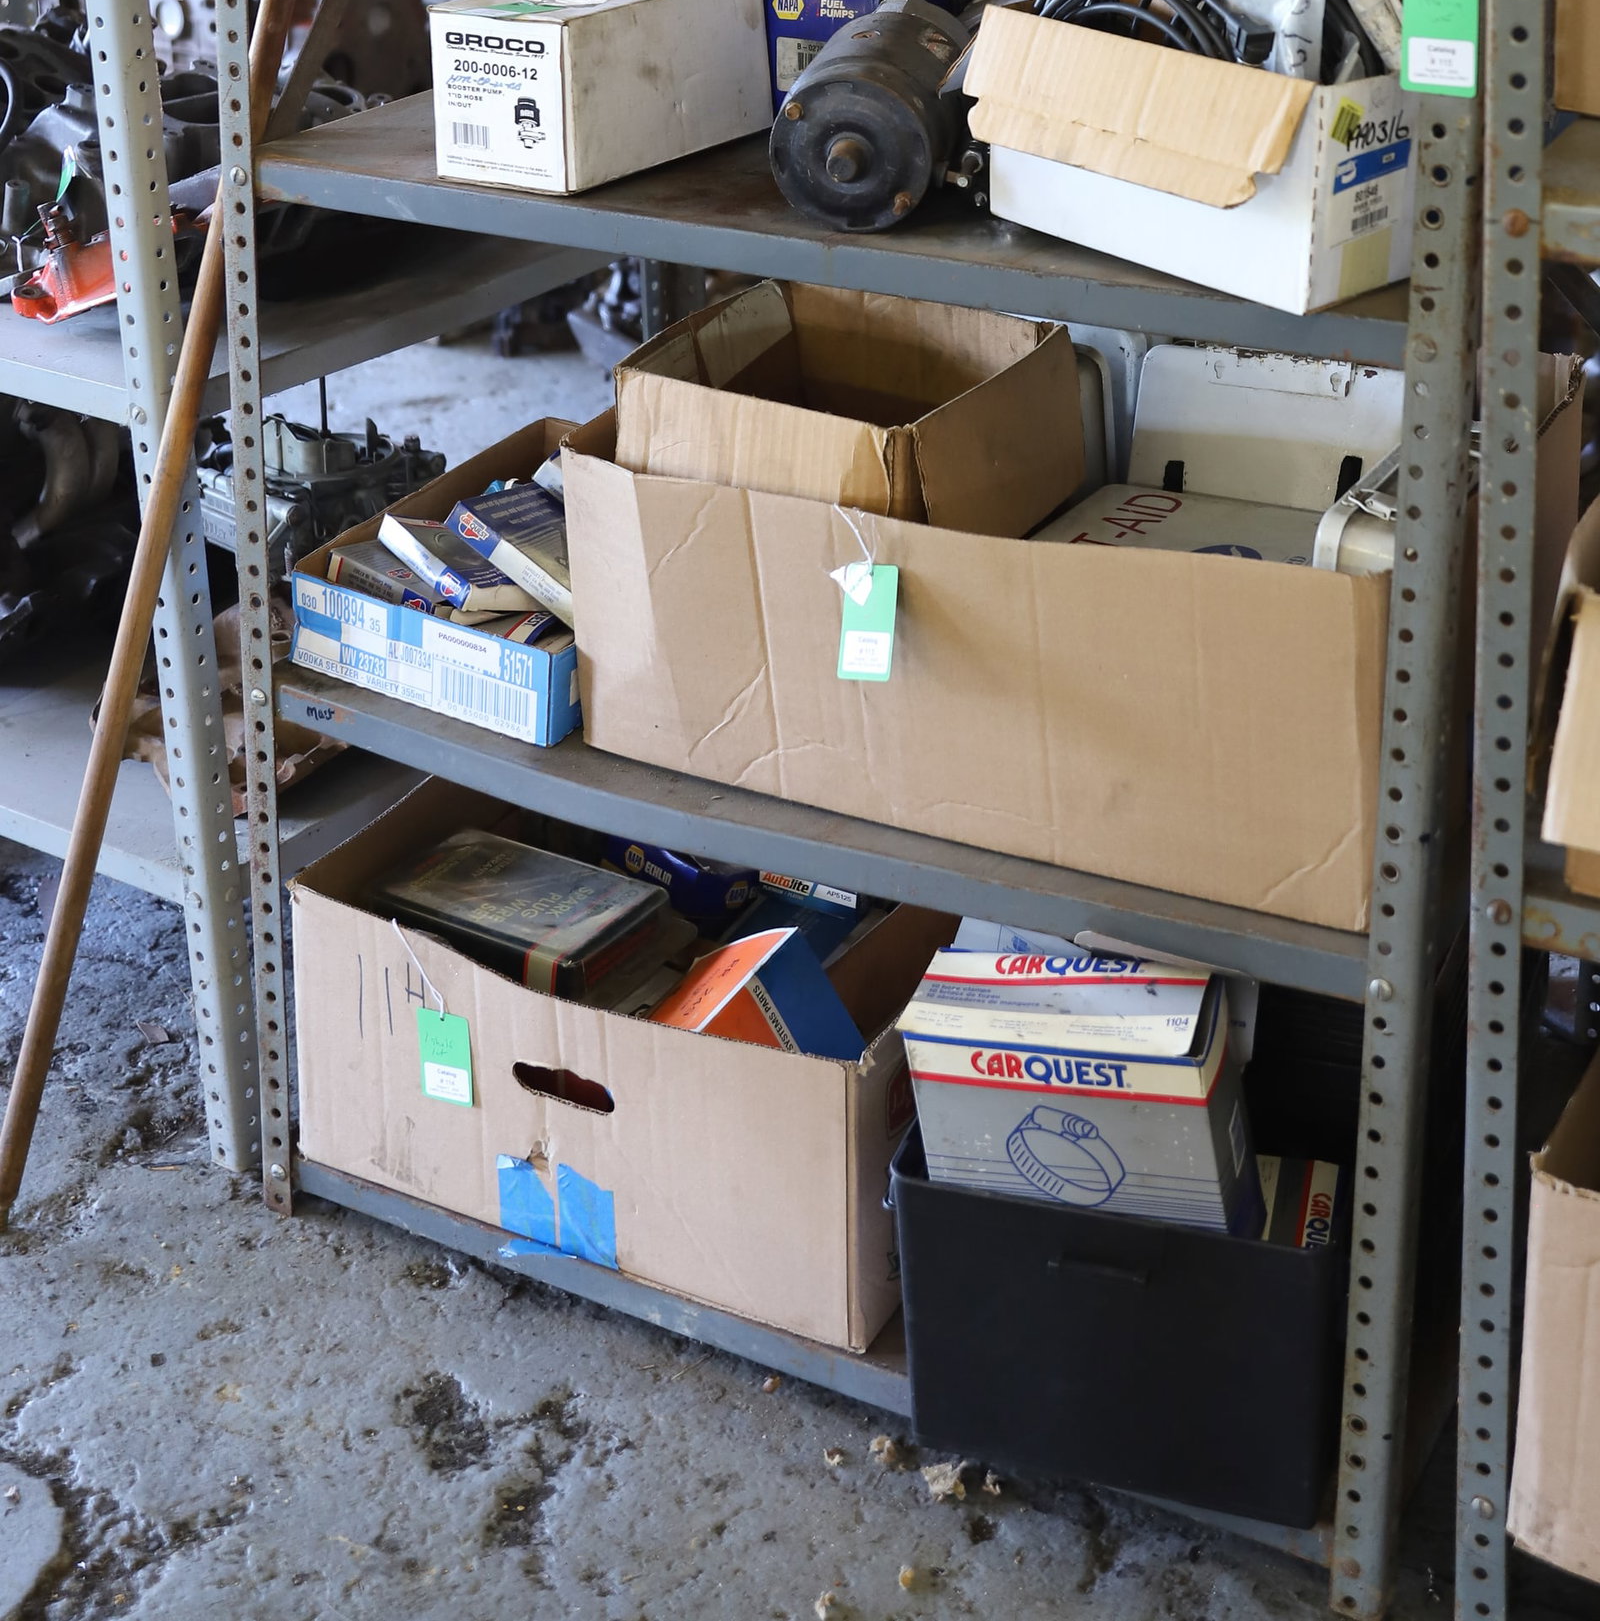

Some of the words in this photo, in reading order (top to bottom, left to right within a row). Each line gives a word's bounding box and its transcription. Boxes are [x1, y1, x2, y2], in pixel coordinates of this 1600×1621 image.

[820, 0, 845, 9] FUEL
[820, 8, 855, 19] PUMPS
[445, 31, 545, 54] GROCO
[453, 59, 539, 80] 200-0006-12
[447, 84, 481, 92] BOOSTER
[301, 593, 317, 610] 030
[322, 587, 365, 629] 100894
[369, 617, 381, 633] 35
[297, 650, 325, 668] VODKA
[325, 660, 359, 680] SELTZER
[366, 674, 400, 693] VARIETY
[359, 651, 386, 678] 23733
[388, 641, 398, 659] AL
[504, 648, 533, 689] 51571
[644, 860, 672, 886] ECHLIN
[761, 871, 811, 895] Autolite
[826, 889, 852, 903] AP5125
[521, 891, 563, 920] PLUG
[544, 885, 596, 918] SPARK
[994, 954, 1144, 976] CARQUEST
[752, 985, 772, 1017] PARTS
[768, 1012, 794, 1052] SYSTEMS
[1166, 1017, 1189, 1027] 1104
[971, 1049, 1128, 1089] CARQUEST
